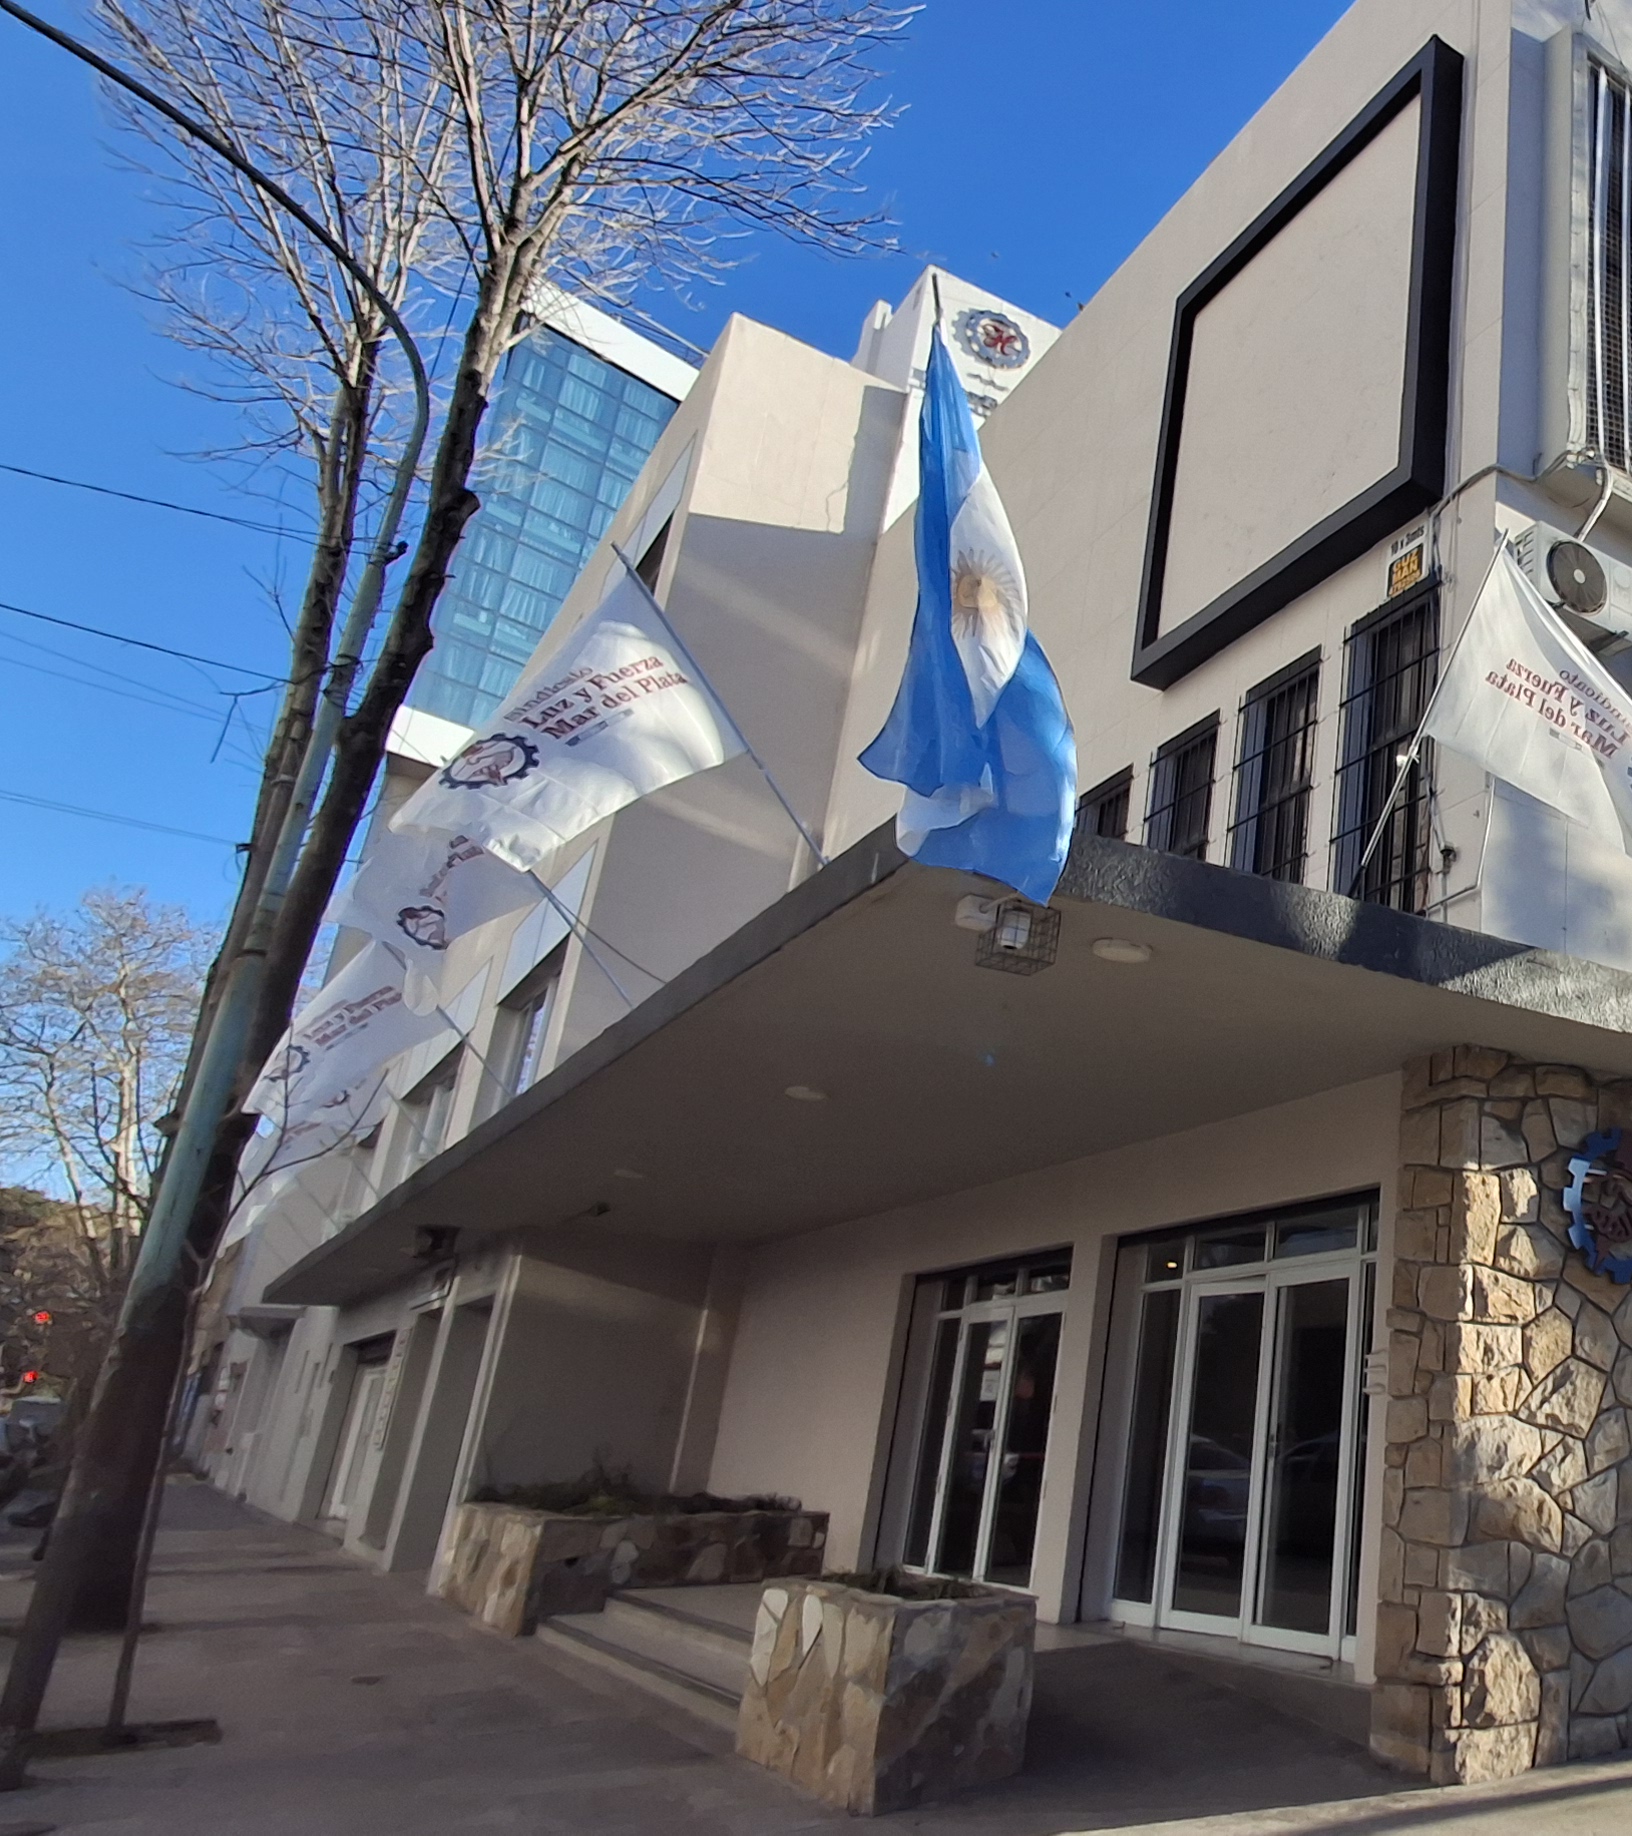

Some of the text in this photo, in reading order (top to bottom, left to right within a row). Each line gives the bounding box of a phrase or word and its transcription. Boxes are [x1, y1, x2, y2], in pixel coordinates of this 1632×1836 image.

[521, 698, 575, 729] Luz
[573, 687, 593, 703] y
[587, 655, 664, 691] Fuerza
[541, 705, 600, 739] Mar
[601, 685, 640, 709] del
[636, 670, 688, 694] Plata
